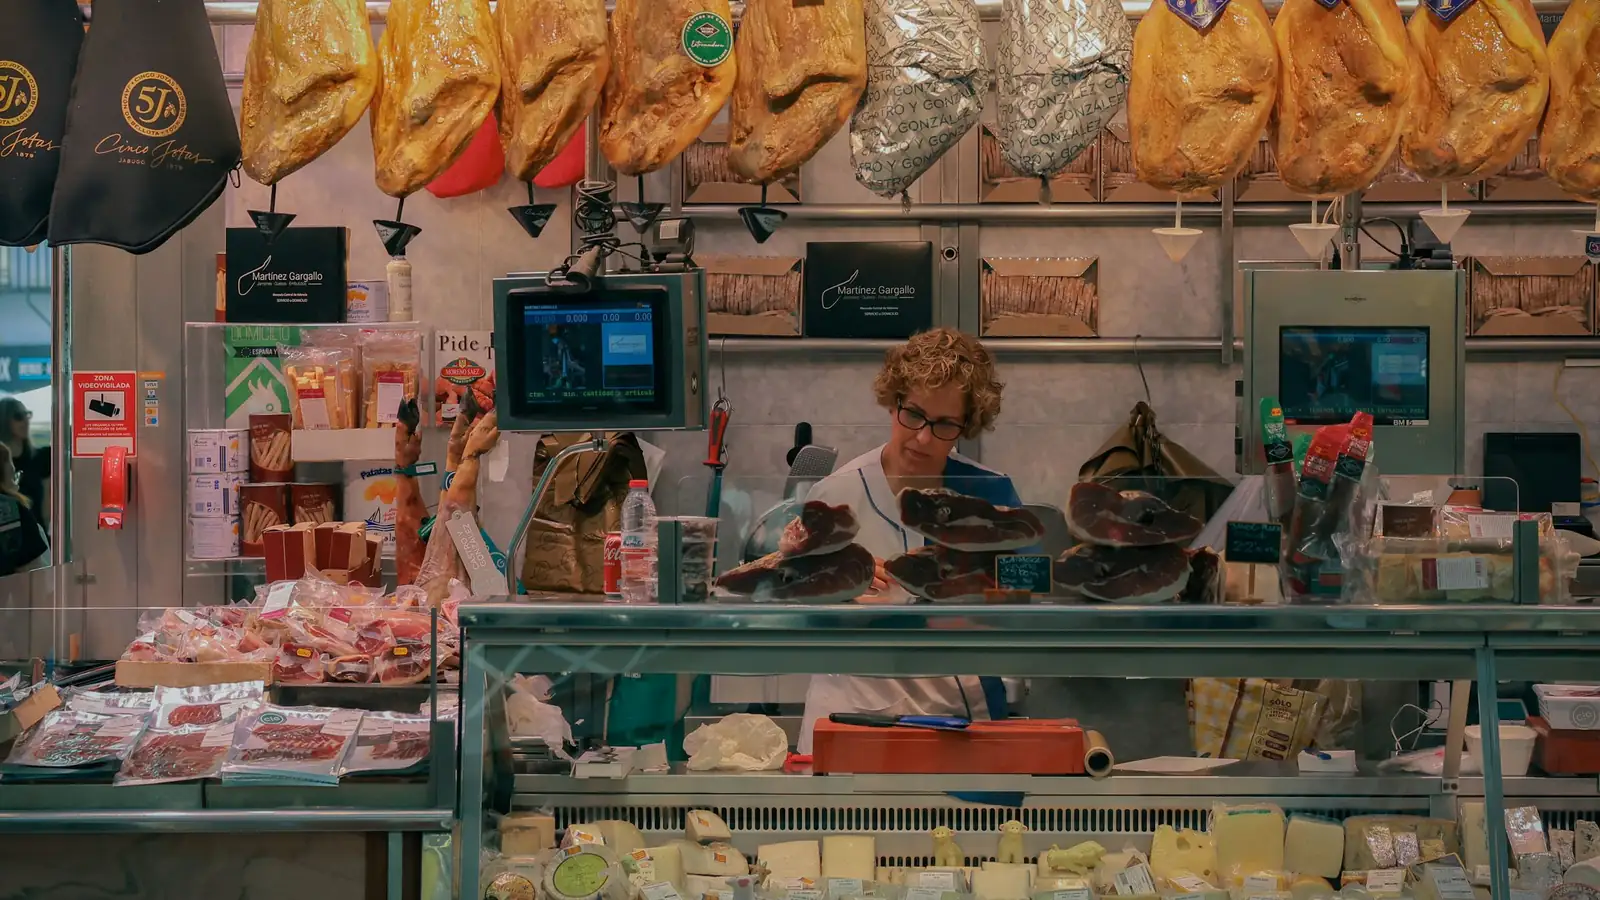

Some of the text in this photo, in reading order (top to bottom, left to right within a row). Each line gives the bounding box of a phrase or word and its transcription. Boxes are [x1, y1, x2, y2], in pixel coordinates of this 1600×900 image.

[134, 72, 176, 87] CINCO JOTAS
[135, 86, 173, 123] 5J
[94, 133, 150, 155] Cinco
[252, 271, 323, 283] Martínez Gargallo
[837, 285, 915, 296] Martínez Gargallo
[565, 314, 588, 323] 0.000
[602, 313, 620, 322] 0.00
[634, 312, 652, 321] 0.00
[439, 335, 480, 351] Pide
[360, 467, 393, 480] Patatas
